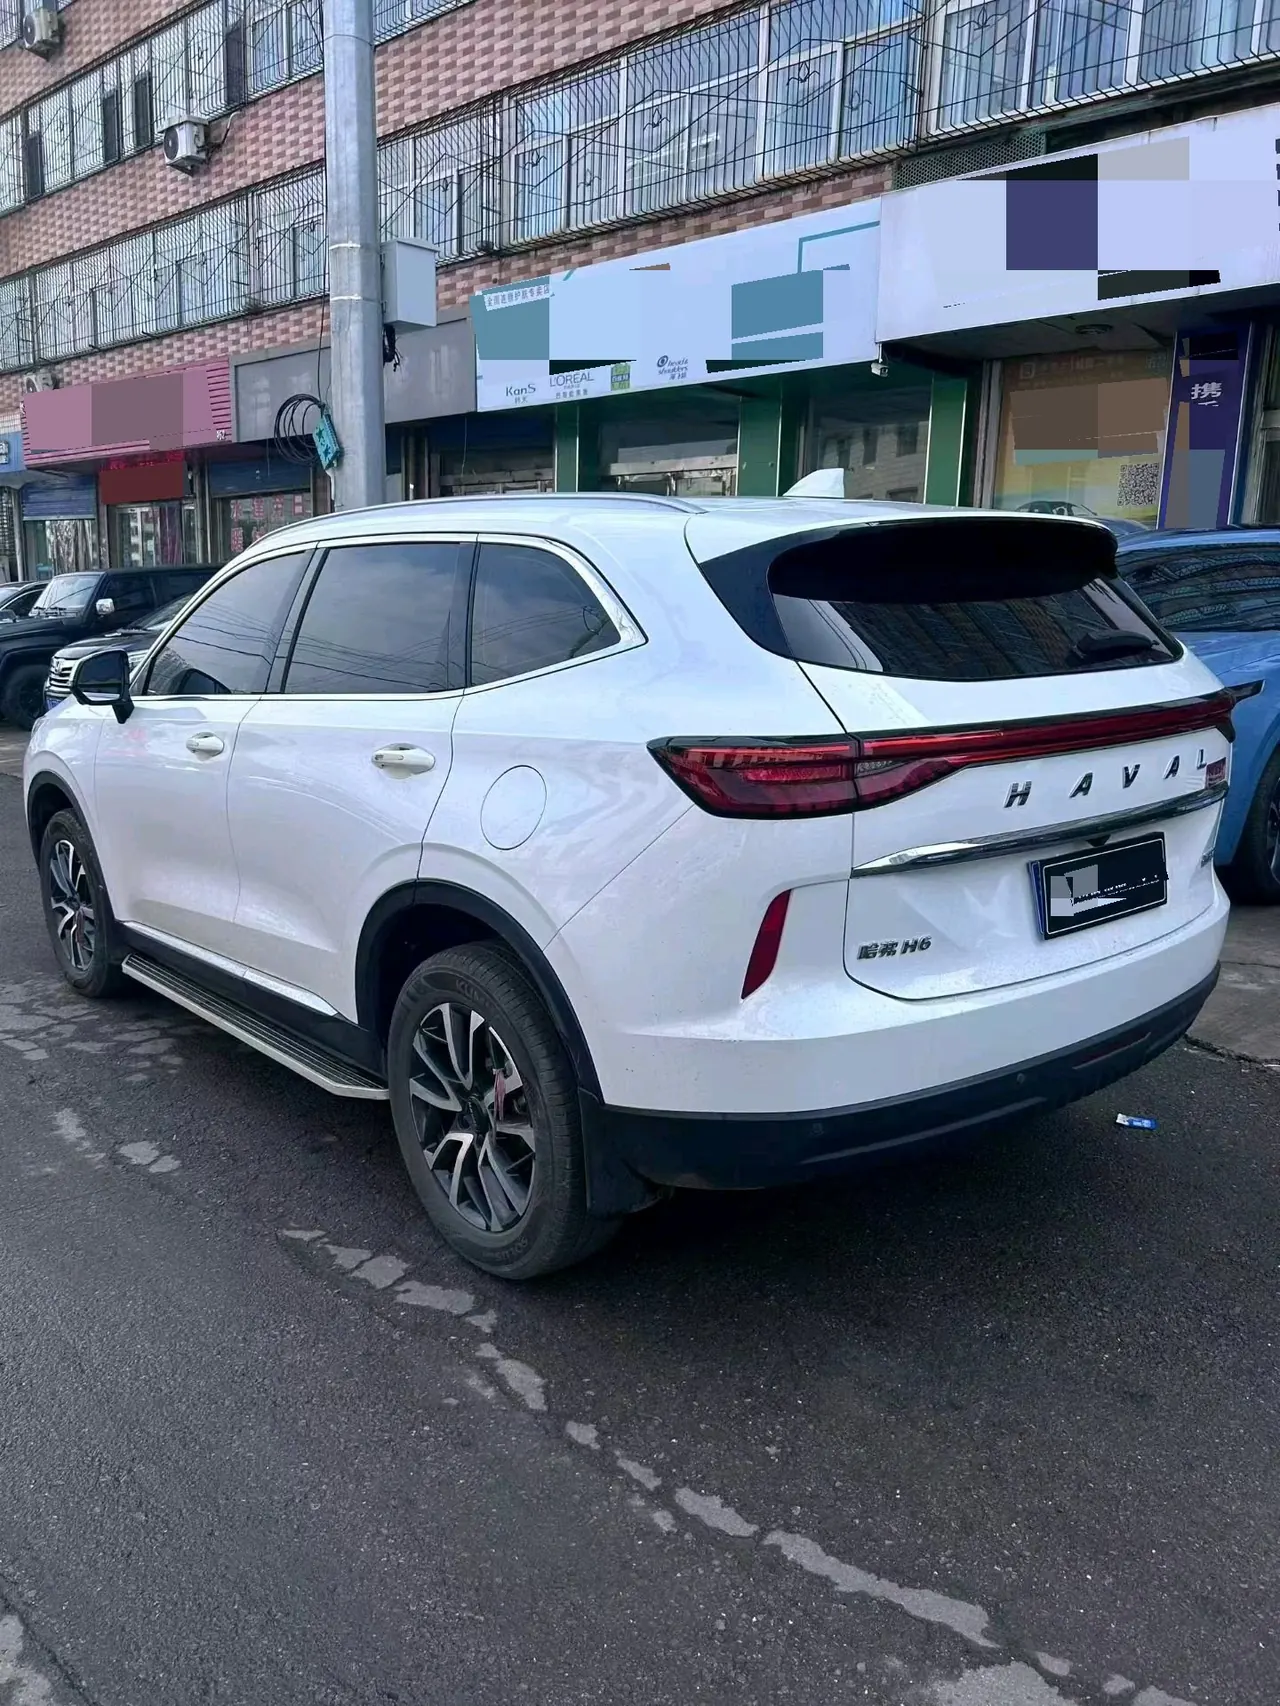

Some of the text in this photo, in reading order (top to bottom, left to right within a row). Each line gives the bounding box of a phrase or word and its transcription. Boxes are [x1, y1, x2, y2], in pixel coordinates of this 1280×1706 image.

[505, 383, 536, 396] KanS
[1004, 748, 1207, 809] HAVAL
[857, 935, 932, 960] 哈弗 H6
